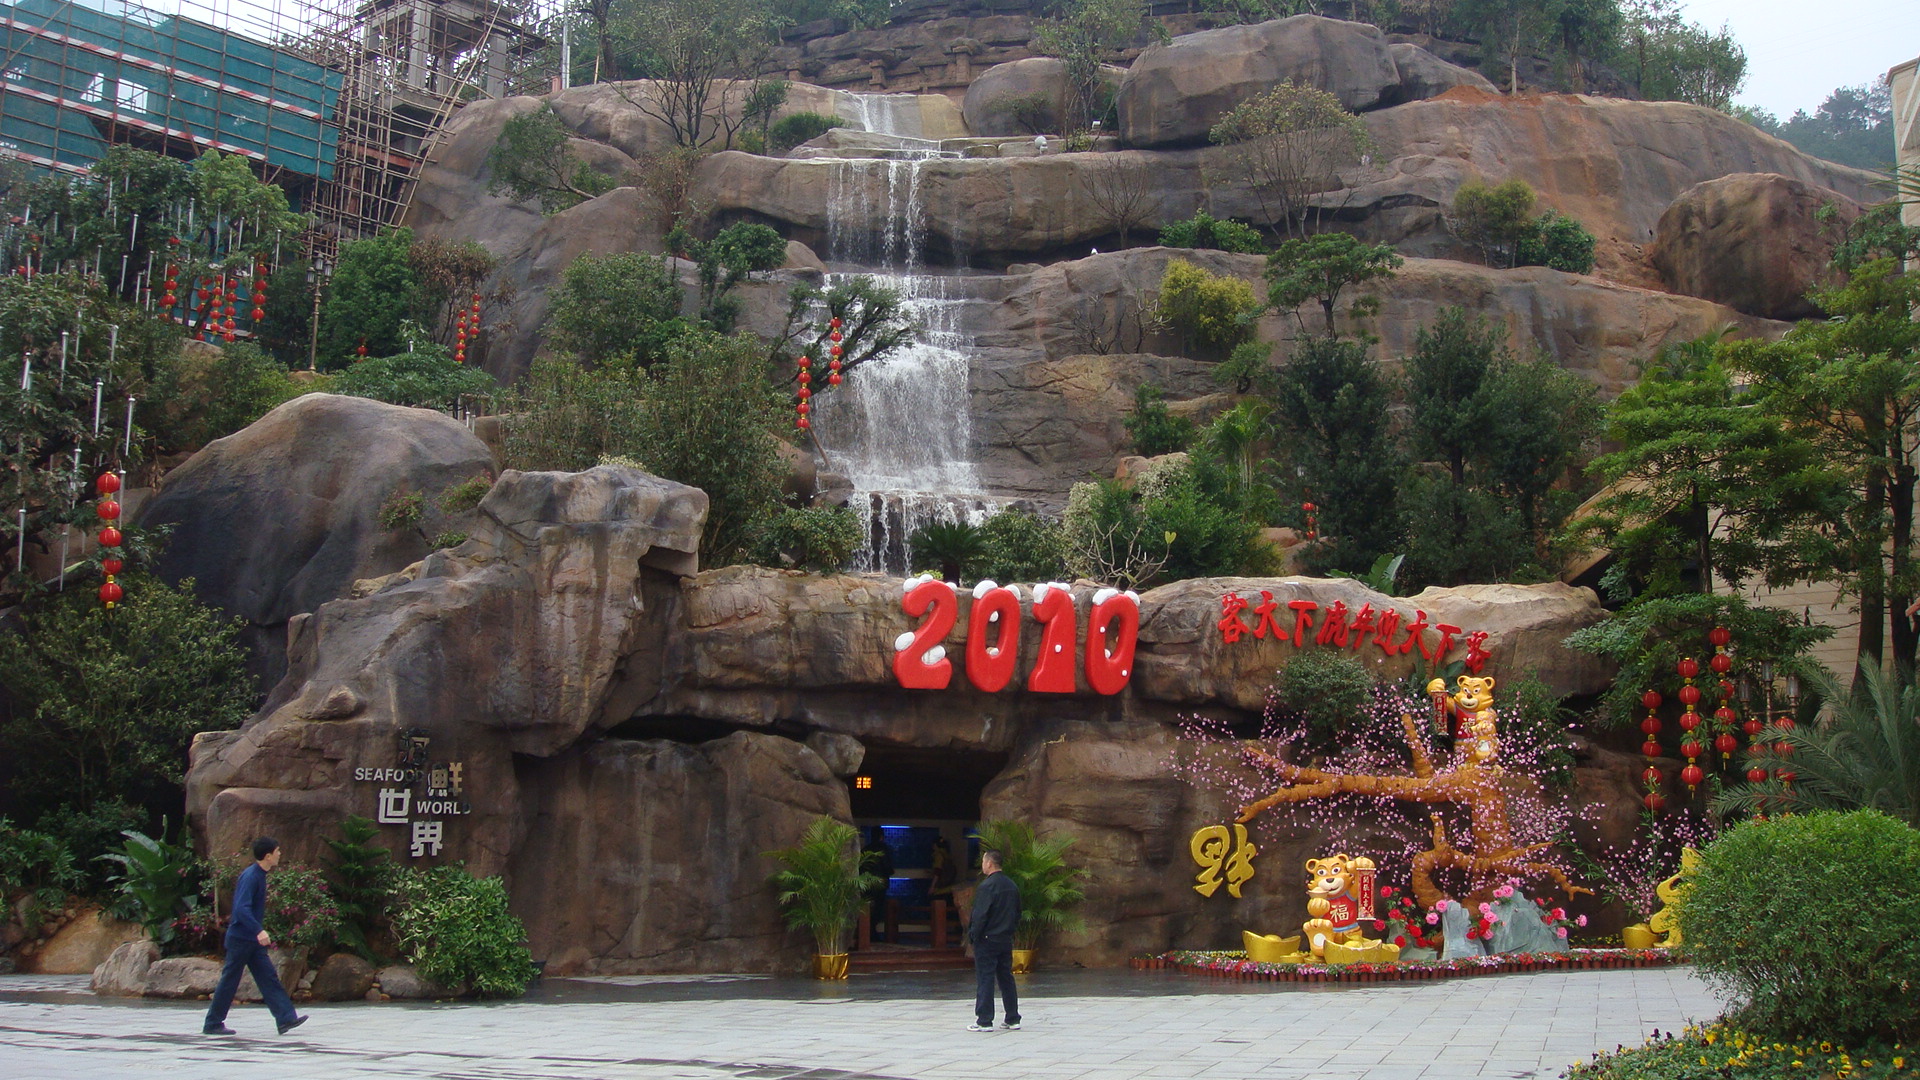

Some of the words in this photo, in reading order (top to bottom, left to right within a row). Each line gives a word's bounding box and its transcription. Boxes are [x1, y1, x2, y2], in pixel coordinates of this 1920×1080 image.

[892, 574, 1140, 696] 2010
[354, 767, 425, 783] SEAFOOD
[416, 801, 472, 815] WORLD
[1329, 903, 1350, 924] 福
